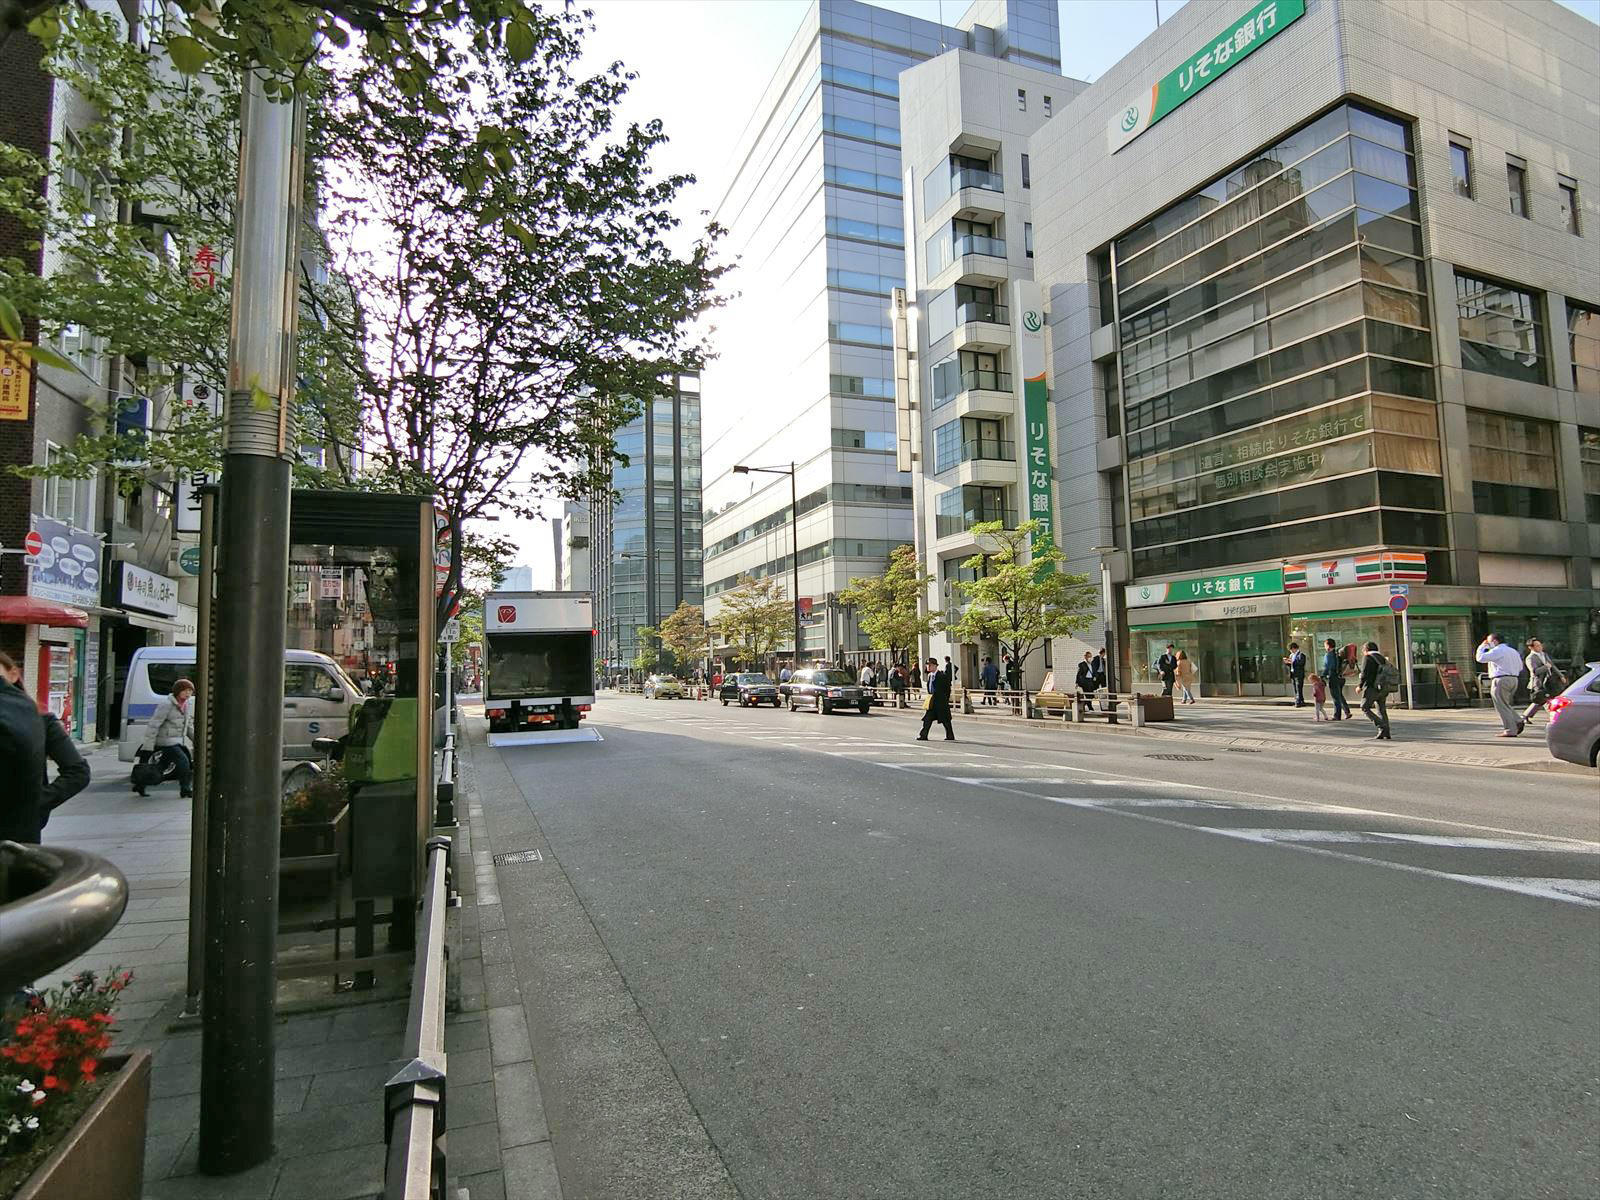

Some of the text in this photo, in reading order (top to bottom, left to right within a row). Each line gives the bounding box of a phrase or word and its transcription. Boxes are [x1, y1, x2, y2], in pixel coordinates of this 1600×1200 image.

[1179, 2, 1278, 91] りそな銀行
[1031, 422, 1050, 542] りそな銀行
[1191, 576, 1255, 596] りそな銀行
